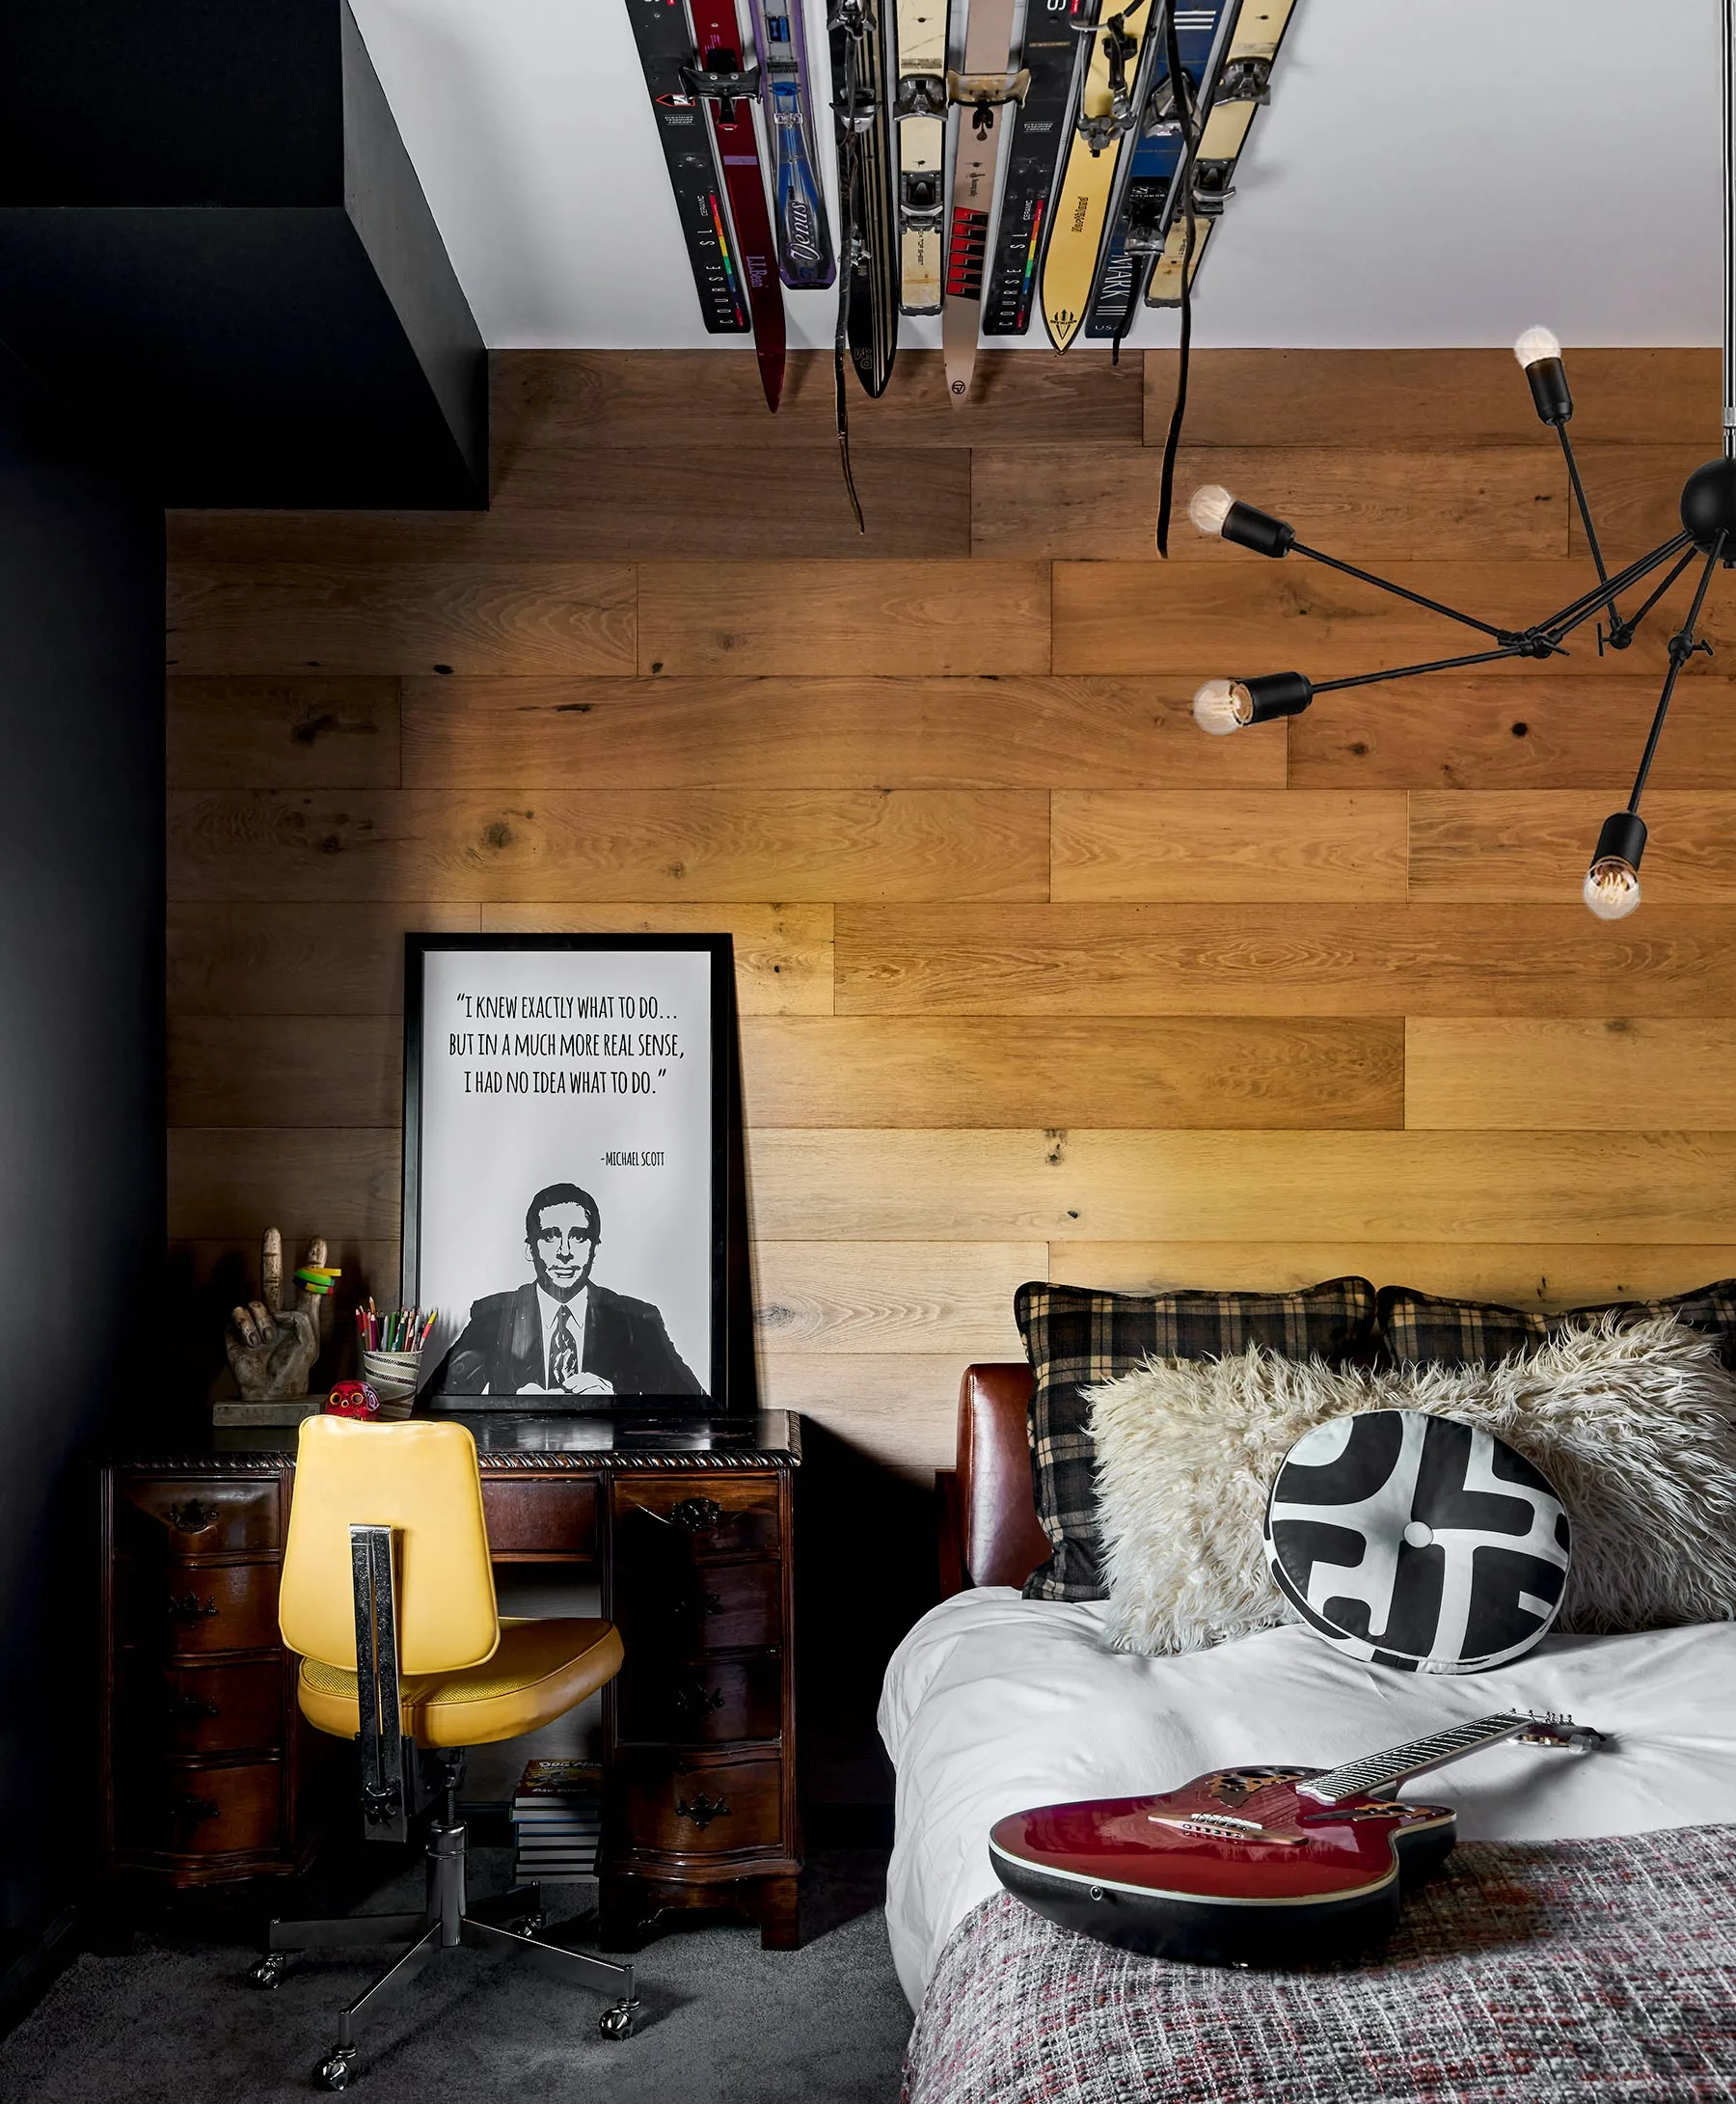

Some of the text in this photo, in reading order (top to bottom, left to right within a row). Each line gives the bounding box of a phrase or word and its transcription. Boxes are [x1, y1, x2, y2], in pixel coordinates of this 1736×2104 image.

[696, 195, 709, 217] CERAMIC
[1022, 199, 1033, 221] CERAMIC
[788, 201, 822, 261] Venus
[697, 229, 734, 325] COURSE SL
[998, 232, 1028, 327] COURSE SL
[1100, 253, 1133, 300] MARK
[476, 996, 518, 1019] KNEW
[522, 996, 574, 1019] EXACTLY
[577, 996, 614, 1020] WHAT
[618, 996, 636, 1019] TO
[449, 1033, 684, 1059] BUT IN A MUCH MORE REAL SENSE,
[464, 1071, 472, 1093] I
[475, 1071, 502, 1094] HAD
[506, 1071, 529, 1094] NO
[532, 1071, 566, 1094] IDEA
[569, 1071, 608, 1095] WHAT
[610, 1071, 628, 1094] TO
[600, 1151, 665, 1166] -MICHAEL SCOTT
